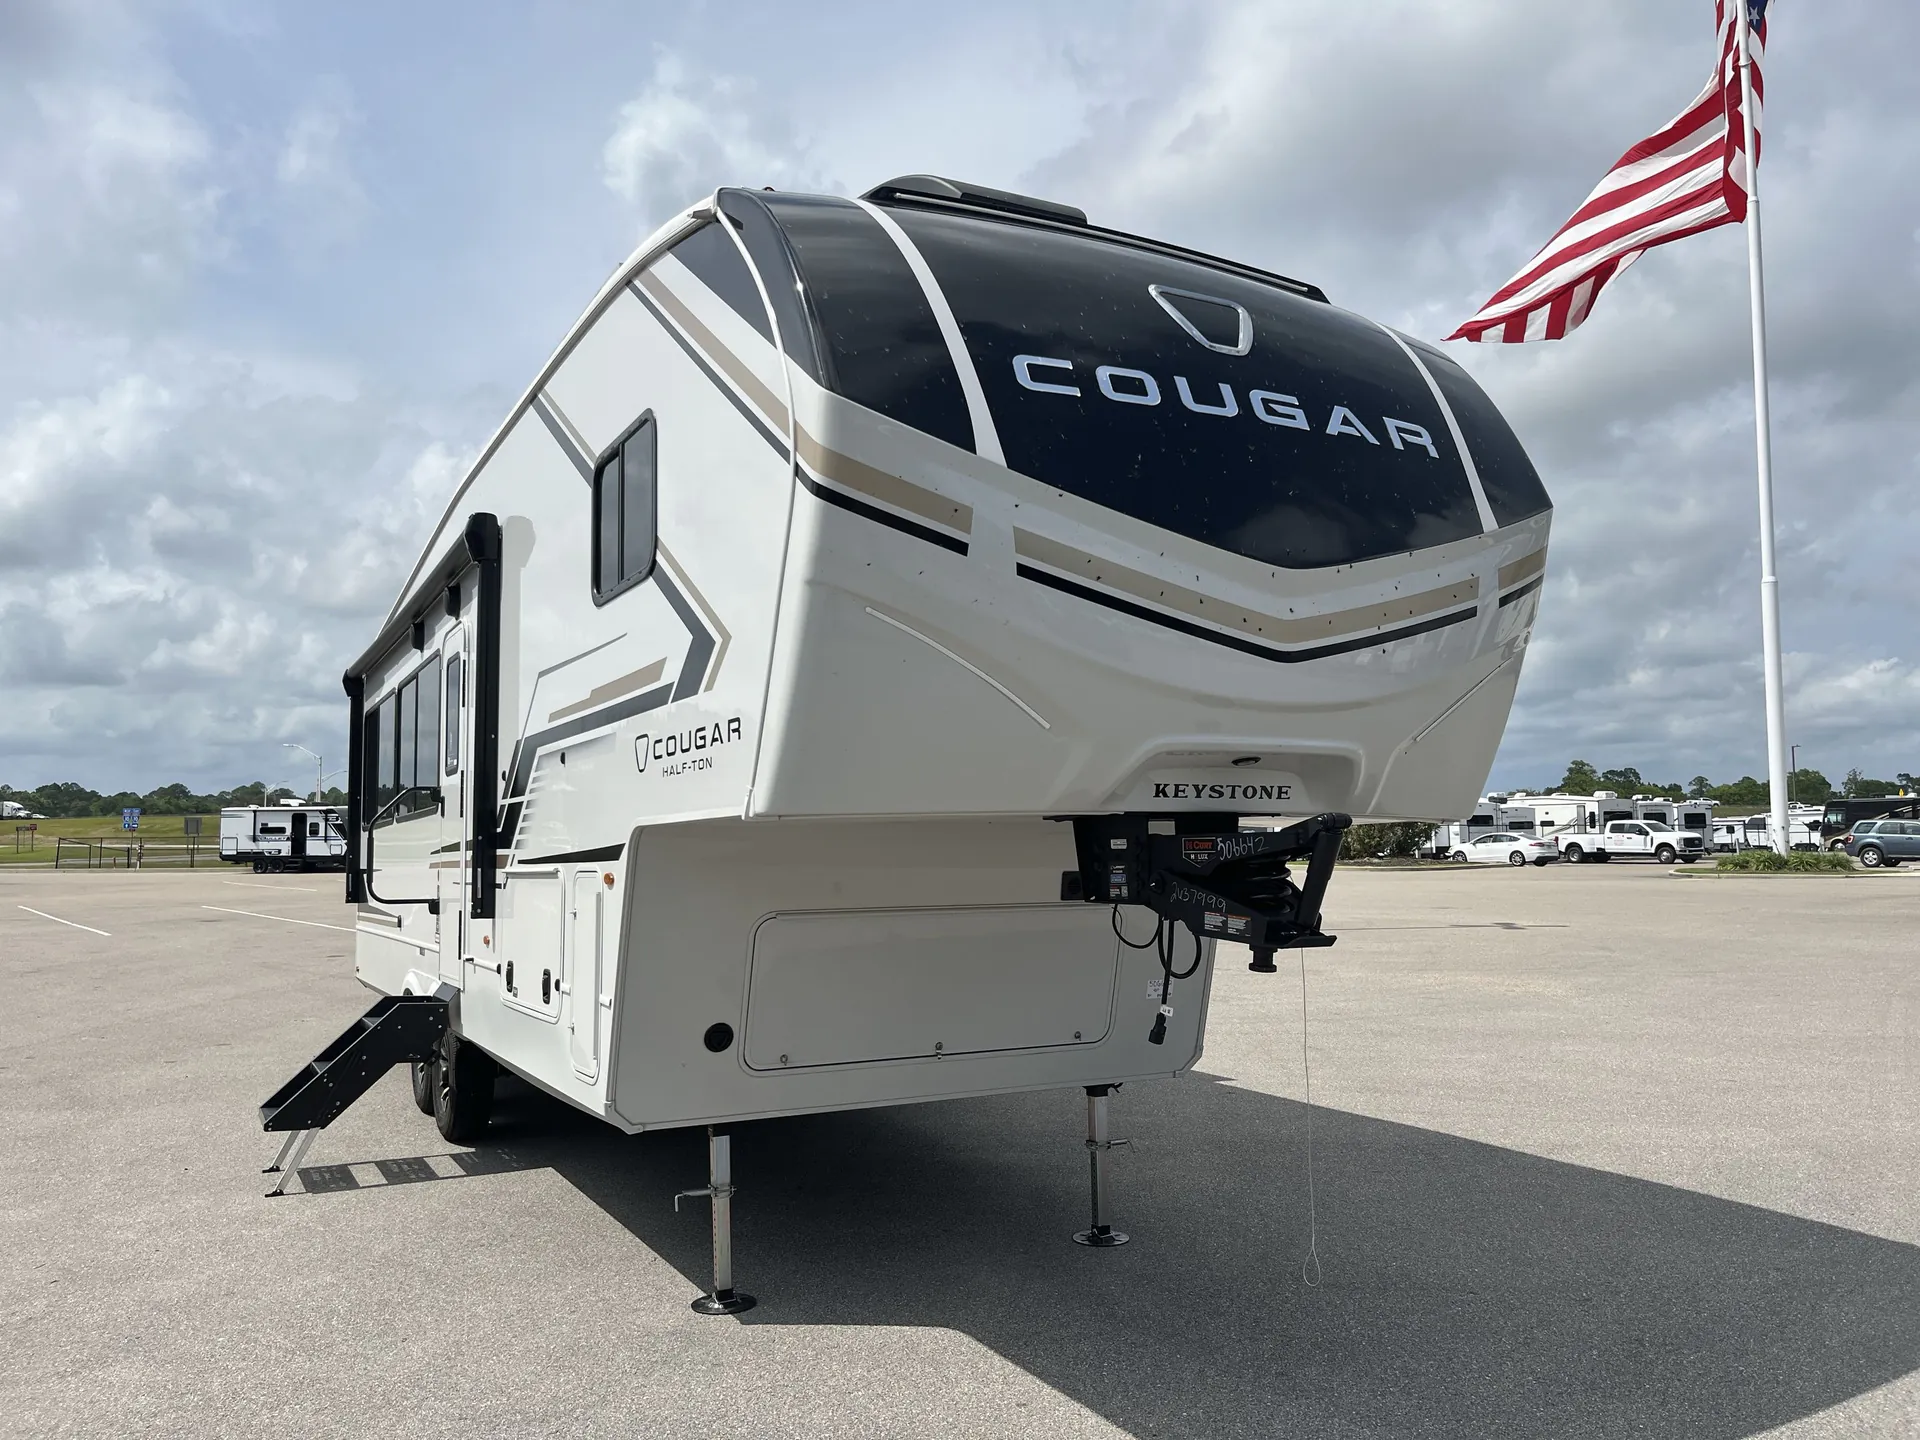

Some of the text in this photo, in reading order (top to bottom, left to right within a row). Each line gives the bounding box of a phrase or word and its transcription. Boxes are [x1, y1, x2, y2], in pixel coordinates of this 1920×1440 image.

[1012, 353, 1439, 459] COUGAR
[653, 717, 741, 760] COUGAR
[662, 757, 713, 778] HALF-TON
[1153, 783, 1292, 800] KEYSTONE
